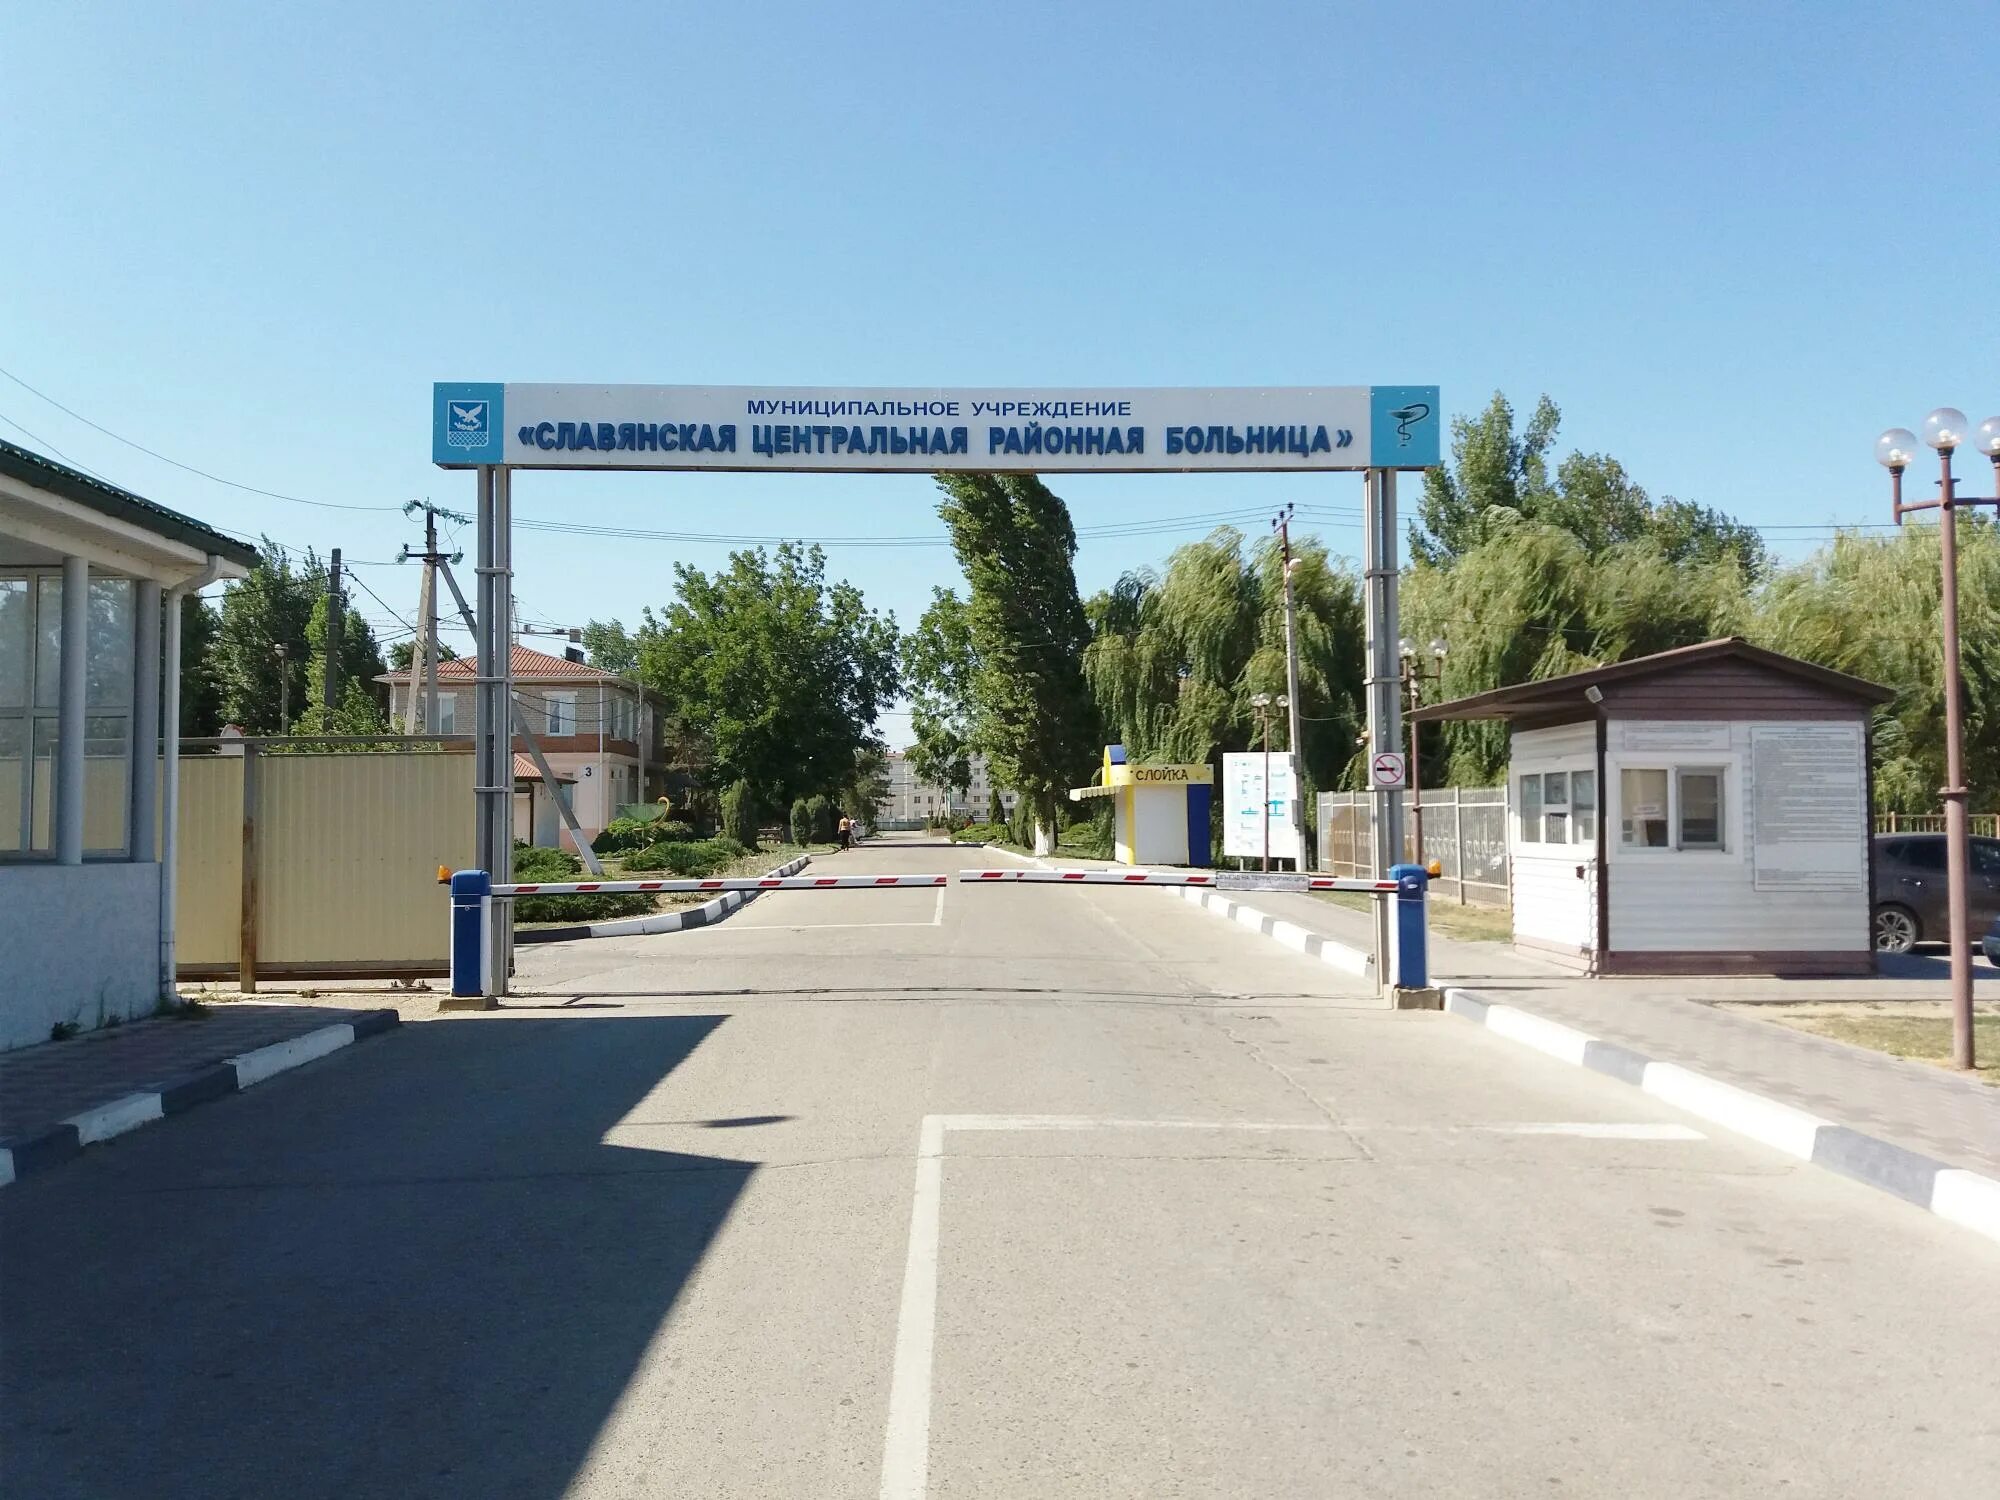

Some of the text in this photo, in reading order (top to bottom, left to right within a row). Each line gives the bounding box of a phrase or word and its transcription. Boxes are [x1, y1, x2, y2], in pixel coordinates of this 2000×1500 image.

[747, 400, 1132, 419] МУНИЦИПАЛЬНОЕ УЧРЕЖДЕНИЕ
[518, 418, 1354, 459] «СЛАВЯНСКАЯ ЦЕНТРАЛЬНАЯ РАЙОННАЯ БОЛЬНИЦА»
[585, 766, 592, 777] 3
[1135, 767, 1189, 781] СЛОЙКА
